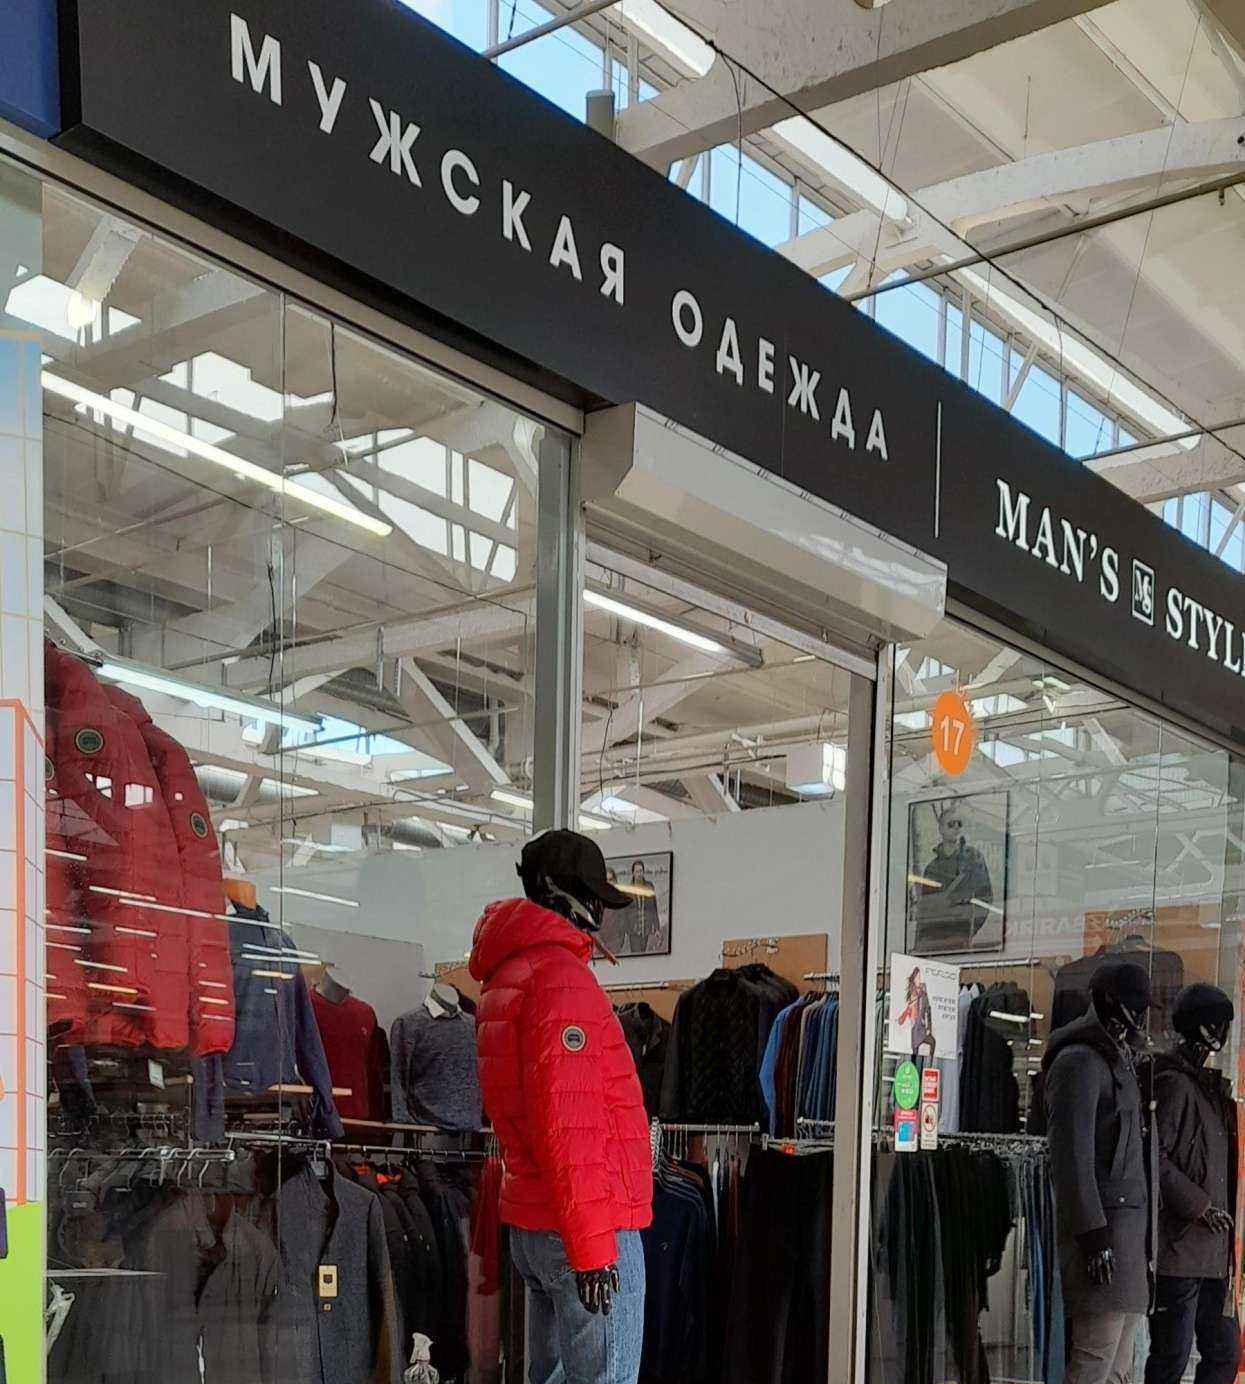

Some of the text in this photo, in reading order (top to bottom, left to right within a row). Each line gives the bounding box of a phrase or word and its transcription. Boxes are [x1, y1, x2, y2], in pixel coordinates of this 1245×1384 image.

[230, 13, 890, 461] МУЖСКАЯ ОДЕЖДА
[995, 478, 1120, 602] MAN'S
[940, 715, 965, 756] 17
